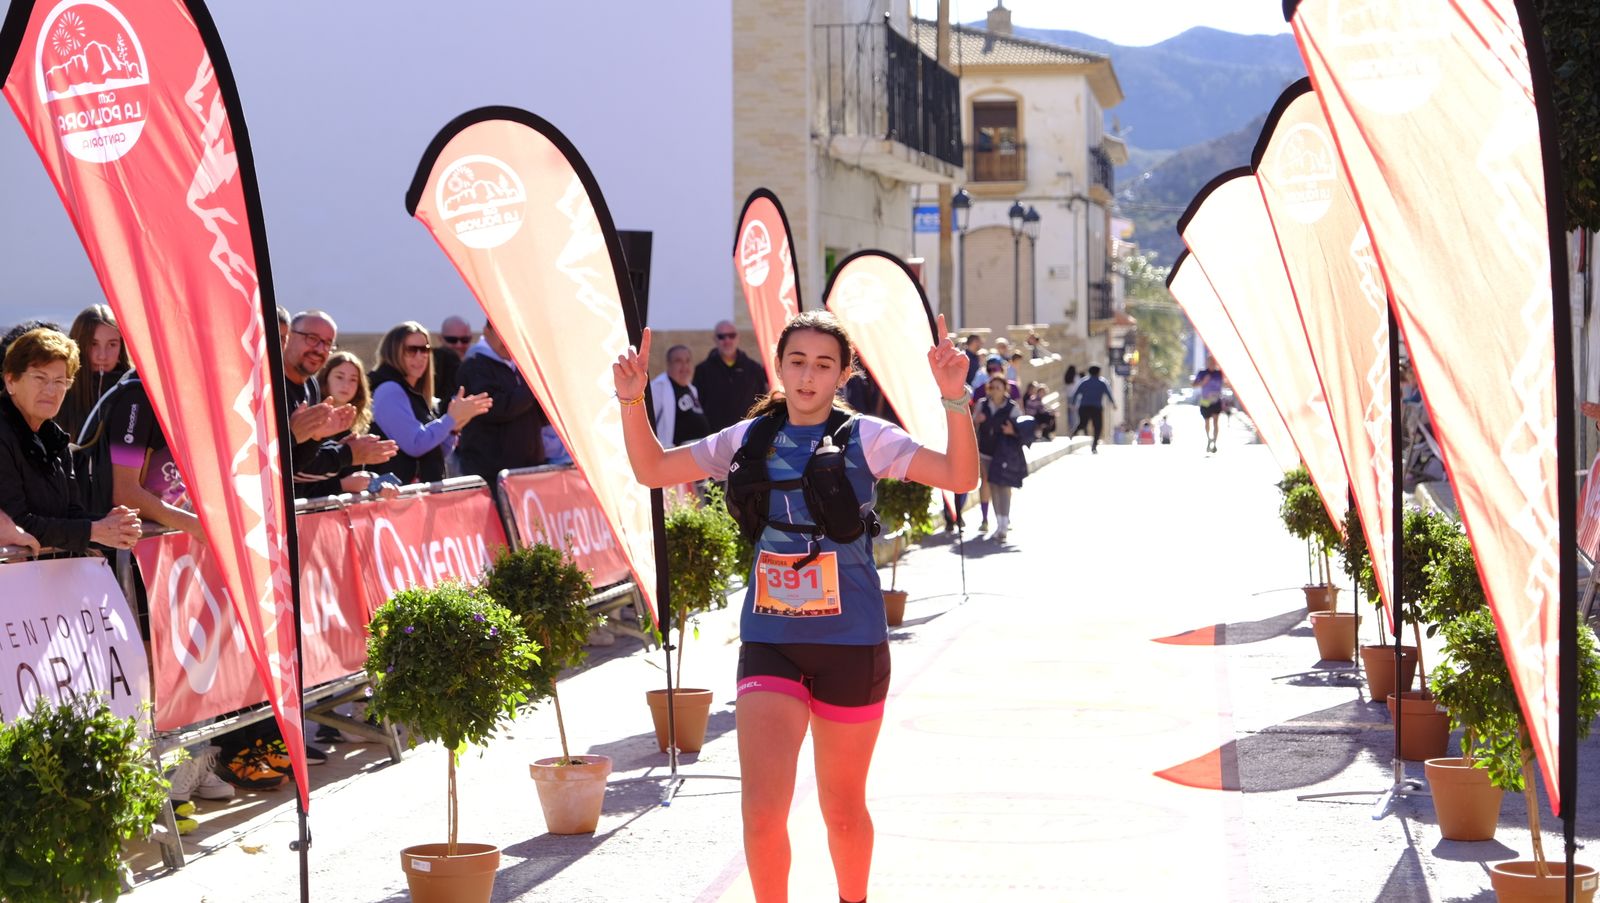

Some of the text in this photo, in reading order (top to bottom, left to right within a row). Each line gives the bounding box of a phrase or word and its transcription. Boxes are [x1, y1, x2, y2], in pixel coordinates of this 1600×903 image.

[767, 568, 818, 590] 391
[0, 606, 114, 650] ENTO DE
[0, 645, 132, 722] ORIA
